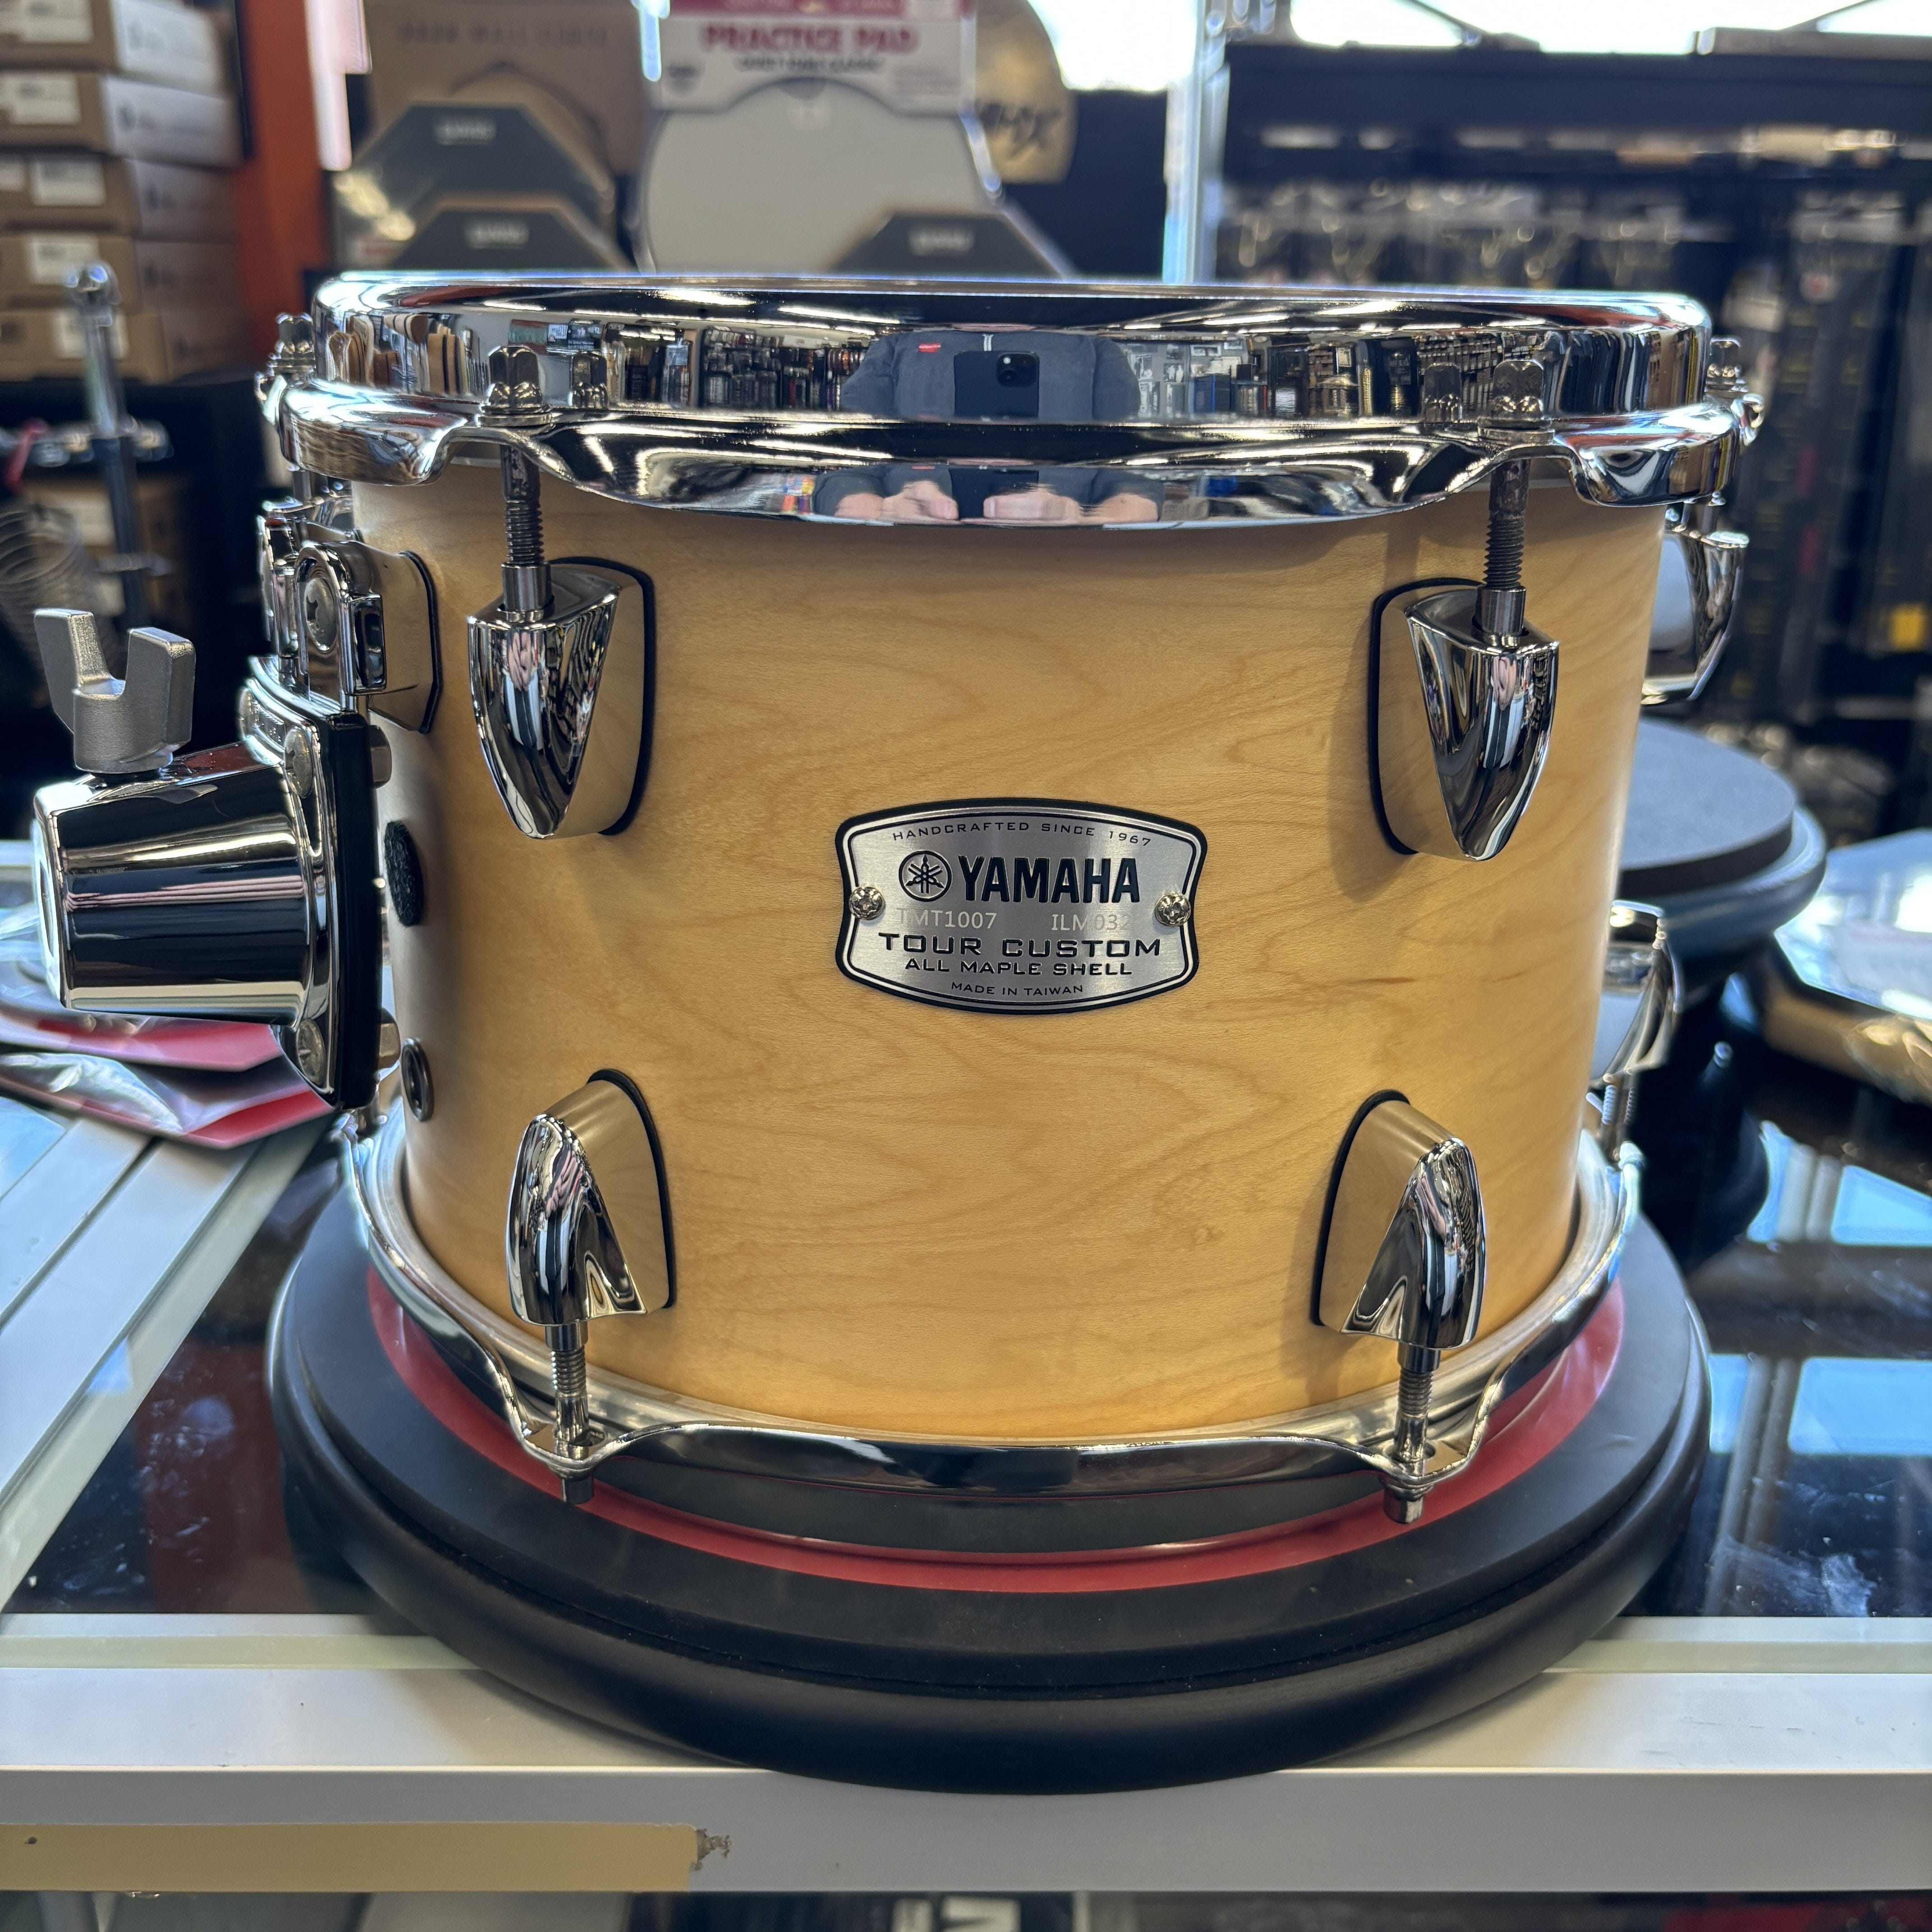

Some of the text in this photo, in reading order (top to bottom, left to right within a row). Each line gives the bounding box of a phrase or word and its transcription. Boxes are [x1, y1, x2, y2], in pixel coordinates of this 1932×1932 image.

[702, 26, 919, 54] PRACTICE PAD
[892, 822, 1151, 846] HANDCRAFTED SINCE 1967
[958, 855, 1140, 903] YAMAHA
[896, 908, 998, 929] TMT1007
[878, 932, 1161, 958] TOUR CUSTOM
[905, 957, 1133, 976] ALL MAPLE SHELL
[951, 981, 1083, 997] MADE IN TAIWAN
